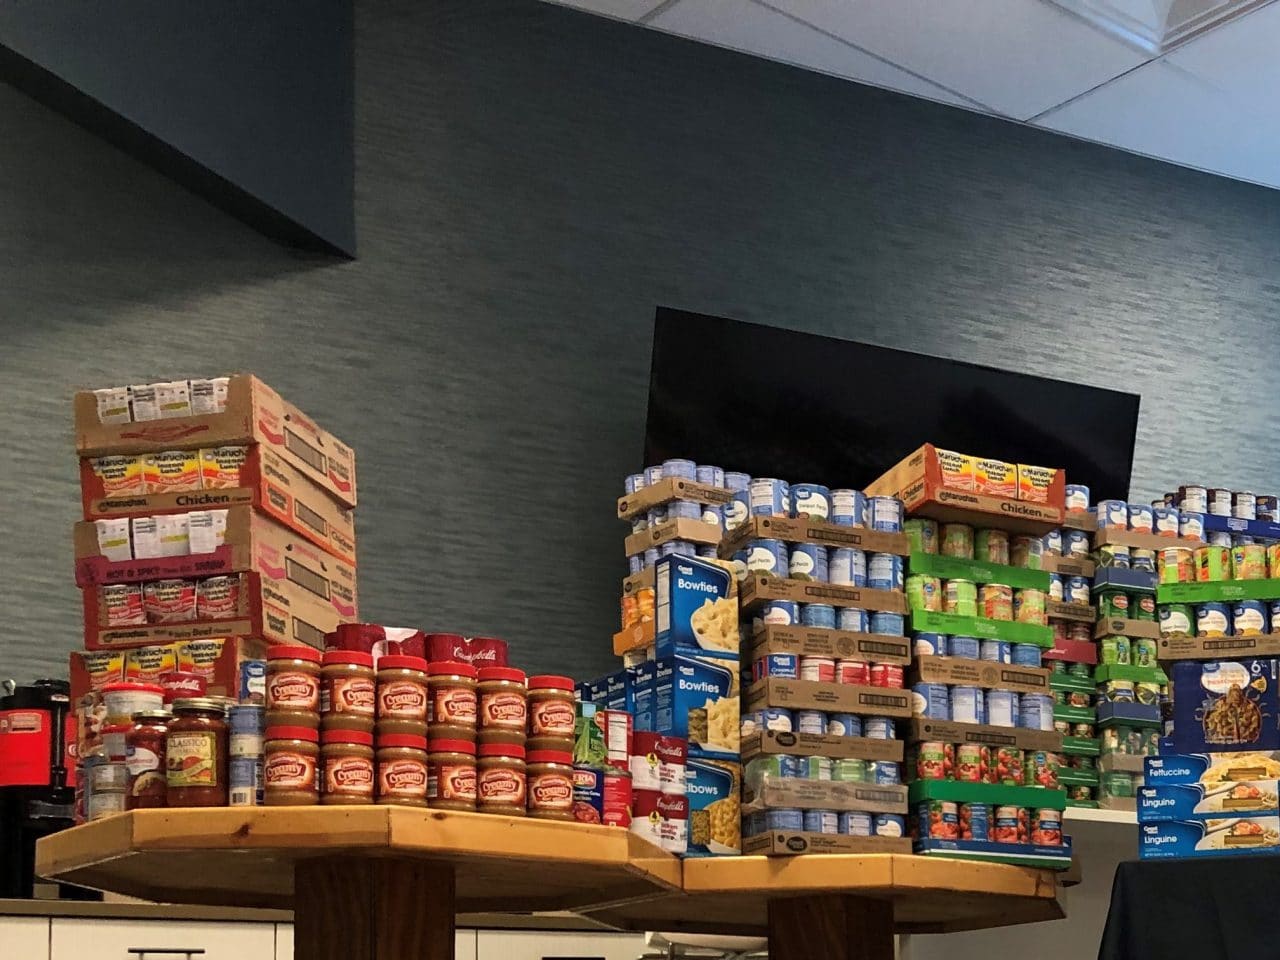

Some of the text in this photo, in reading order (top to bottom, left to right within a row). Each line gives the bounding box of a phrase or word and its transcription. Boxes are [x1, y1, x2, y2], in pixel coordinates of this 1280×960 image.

[154, 452, 195, 462] Maruchan
[176, 493, 230, 507] Chicken
[1000, 502, 1043, 518] Chicken
[678, 577, 719, 595] Bowties
[678, 678, 720, 694] Bowties
[573, 771, 595, 783] ERIA
[1149, 768, 1191, 777] Fettuccine
[1142, 798, 1176, 809] Linguine
[1144, 835, 1178, 845] Linguine
